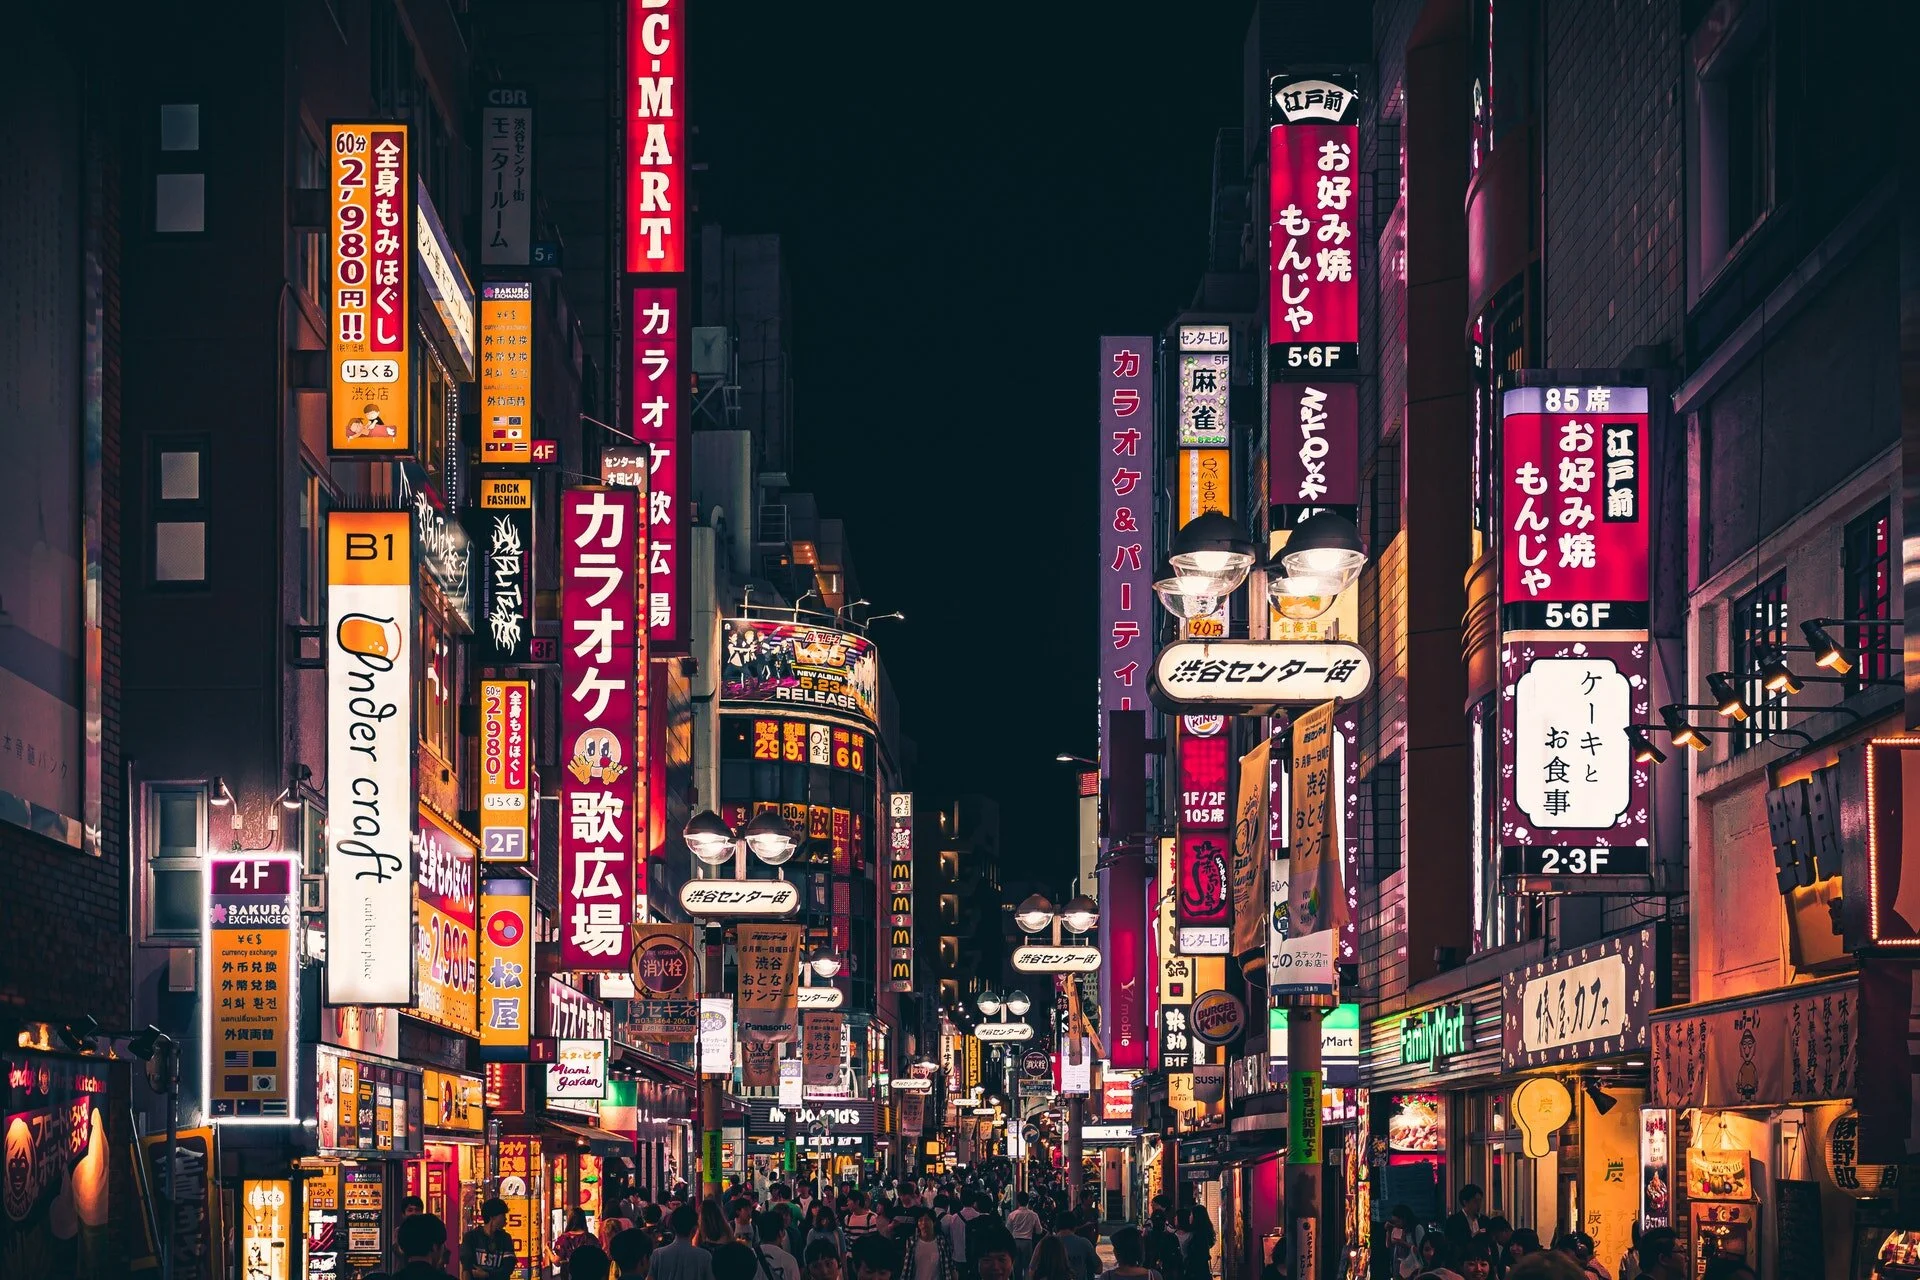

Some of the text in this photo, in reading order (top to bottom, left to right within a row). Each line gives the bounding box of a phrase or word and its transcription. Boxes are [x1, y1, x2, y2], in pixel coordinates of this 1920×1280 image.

[1284, 89, 1344, 113] 江戸前
[638, 0, 673, 259] C-MART
[336, 132, 366, 154] 60分
[513, 117, 527, 202] 渋谷センター街
[490, 117, 510, 249] モニタールーム
[1316, 140, 1351, 282] お好み焼
[374, 137, 400, 345] 全身もみほぐし
[1277, 203, 1314, 333] もんじゃ
[1180, 331, 1228, 346] センタービル
[1214, 355, 1229, 365] 5F
[346, 364, 394, 379] りらくる
[351, 387, 390, 401] 渋谷店
[1191, 369, 1218, 430] 麻雀
[1545, 388, 1611, 412] 85席
[533, 445, 555, 460] 4F
[604, 456, 645, 469] センター街
[1606, 428, 1634, 518] 江戸前
[493, 483, 520, 494] ROCK
[1558, 420, 1596, 569] お好み焼
[487, 495, 527, 506] FASHION
[1514, 461, 1552, 597] もんじゃ
[345, 532, 395, 562] B1
[1280, 621, 1318, 633] 北海道
[534, 641, 556, 660] 3F
[796, 669, 843, 682] NEW ALBUM
[1168, 659, 1362, 683] 渋谷センター街
[800, 677, 840, 693] 5.23
[776, 686, 856, 710] RELEASE
[570, 492, 626, 957] カラオケ 歌広場
[1191, 714, 1219, 728] KING
[1579, 671, 1603, 784] ケーキと
[508, 691, 523, 786] 全身もみほぐし
[1543, 727, 1572, 816] お食事
[1306, 768, 1328, 798] 渋谷
[487, 796, 522, 807] りらくる
[1184, 808, 1225, 822] 105席
[337, 776, 402, 884] craft
[490, 833, 520, 852] 2F
[230, 860, 270, 890] 4F
[686, 889, 792, 905] 渋谷センター街
[228, 904, 290, 915] SAKURA
[1180, 934, 1229, 947] センタービル
[221, 949, 247, 958] currency
[1017, 953, 1098, 964] 渋谷センター街
[1272, 951, 1328, 968] この ステッカー
[643, 958, 684, 978] 消火栓
[755, 956, 783, 971] 渋谷
[741, 973, 794, 986] おとなり
[487, 957, 524, 1031] 松屋
[741, 989, 796, 1002] サンデー
[1198, 1001, 1235, 1019] BURGER
[745, 1022, 792, 1032] Panasonic
[1200, 1010, 1238, 1032] KING
[1400, 1003, 1465, 1072] FamilyMart
[560, 1051, 602, 1061] スタ・ピザ
[1164, 1056, 1188, 1067] B1F
[549, 1063, 591, 1075] Miami
